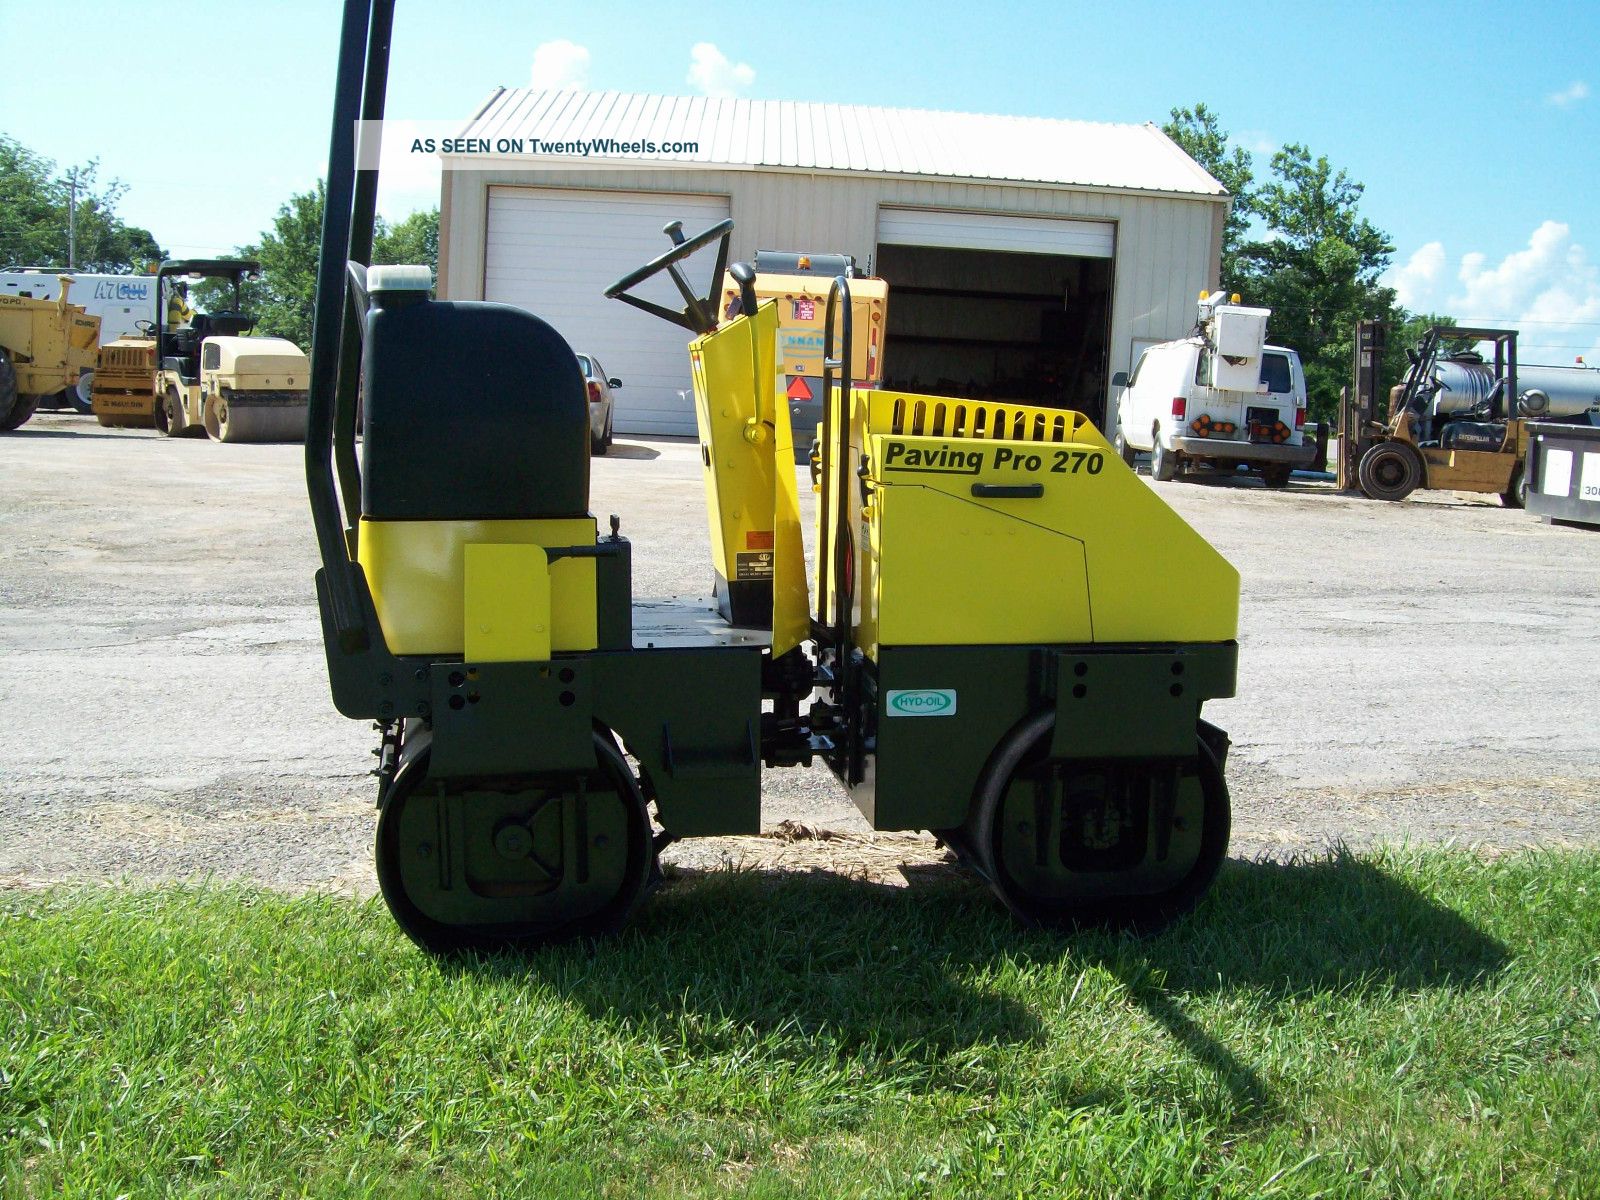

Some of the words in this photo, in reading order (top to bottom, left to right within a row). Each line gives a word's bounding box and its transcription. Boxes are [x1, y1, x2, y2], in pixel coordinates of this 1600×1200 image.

[885, 442, 984, 475] Paving
[993, 447, 1042, 472] Pro
[1050, 450, 1104, 475] 270
[1584, 485, 1600, 496] 30
[900, 697, 943, 706] HYD-OIL
